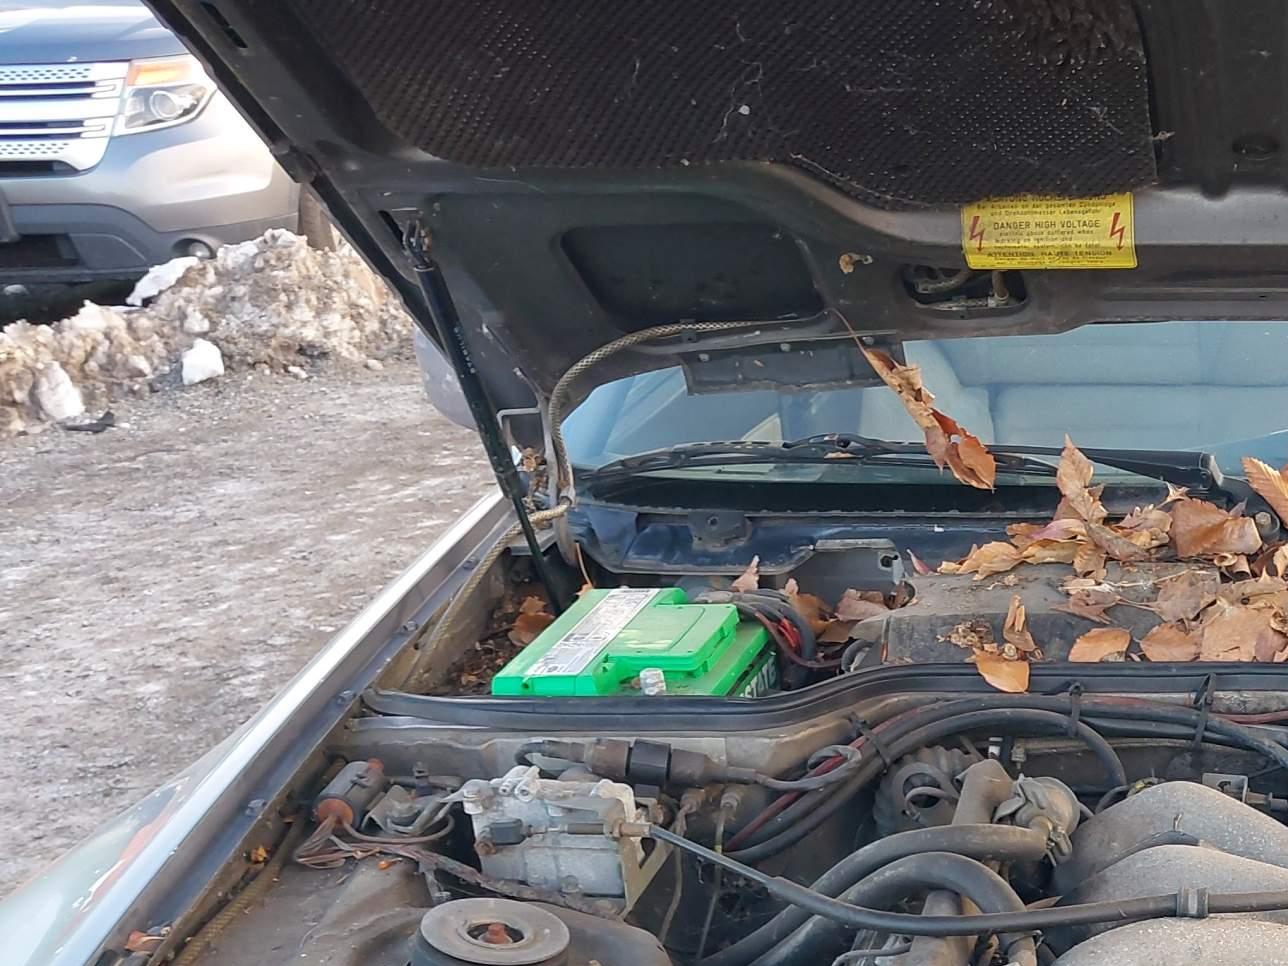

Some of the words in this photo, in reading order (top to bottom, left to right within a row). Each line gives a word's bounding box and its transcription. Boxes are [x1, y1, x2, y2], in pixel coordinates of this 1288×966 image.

[993, 221, 1031, 231] DANGER
[1034, 220, 1057, 229] HIGH
[1059, 219, 1101, 229] VOLTAGE
